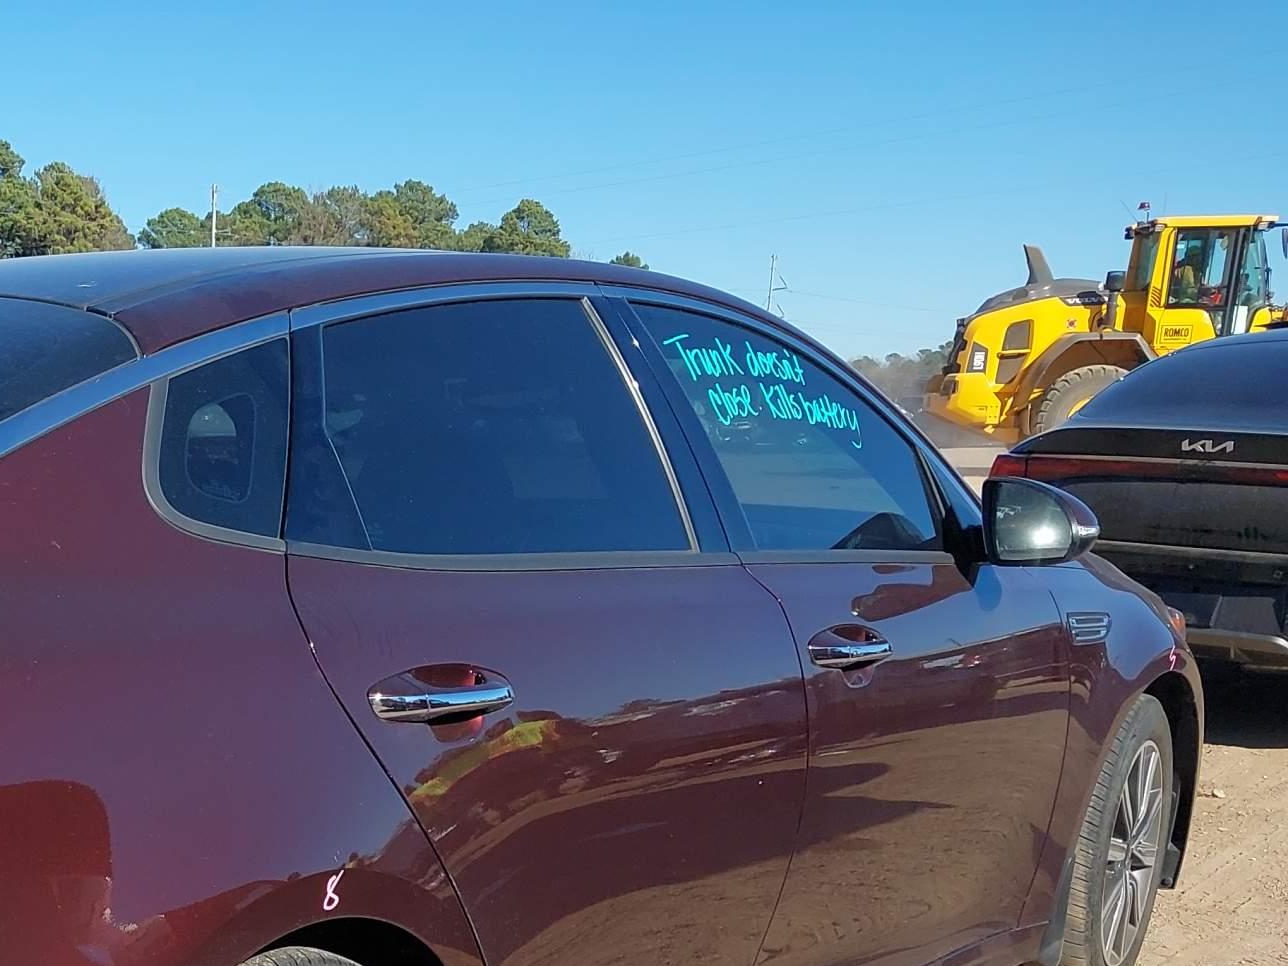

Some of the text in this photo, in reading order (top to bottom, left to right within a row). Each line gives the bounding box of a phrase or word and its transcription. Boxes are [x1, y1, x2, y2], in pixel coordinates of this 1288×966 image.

[1163, 327, 1190, 337] ROMCO
[663, 334, 744, 381] Trunk
[798, 393, 862, 449] battery
